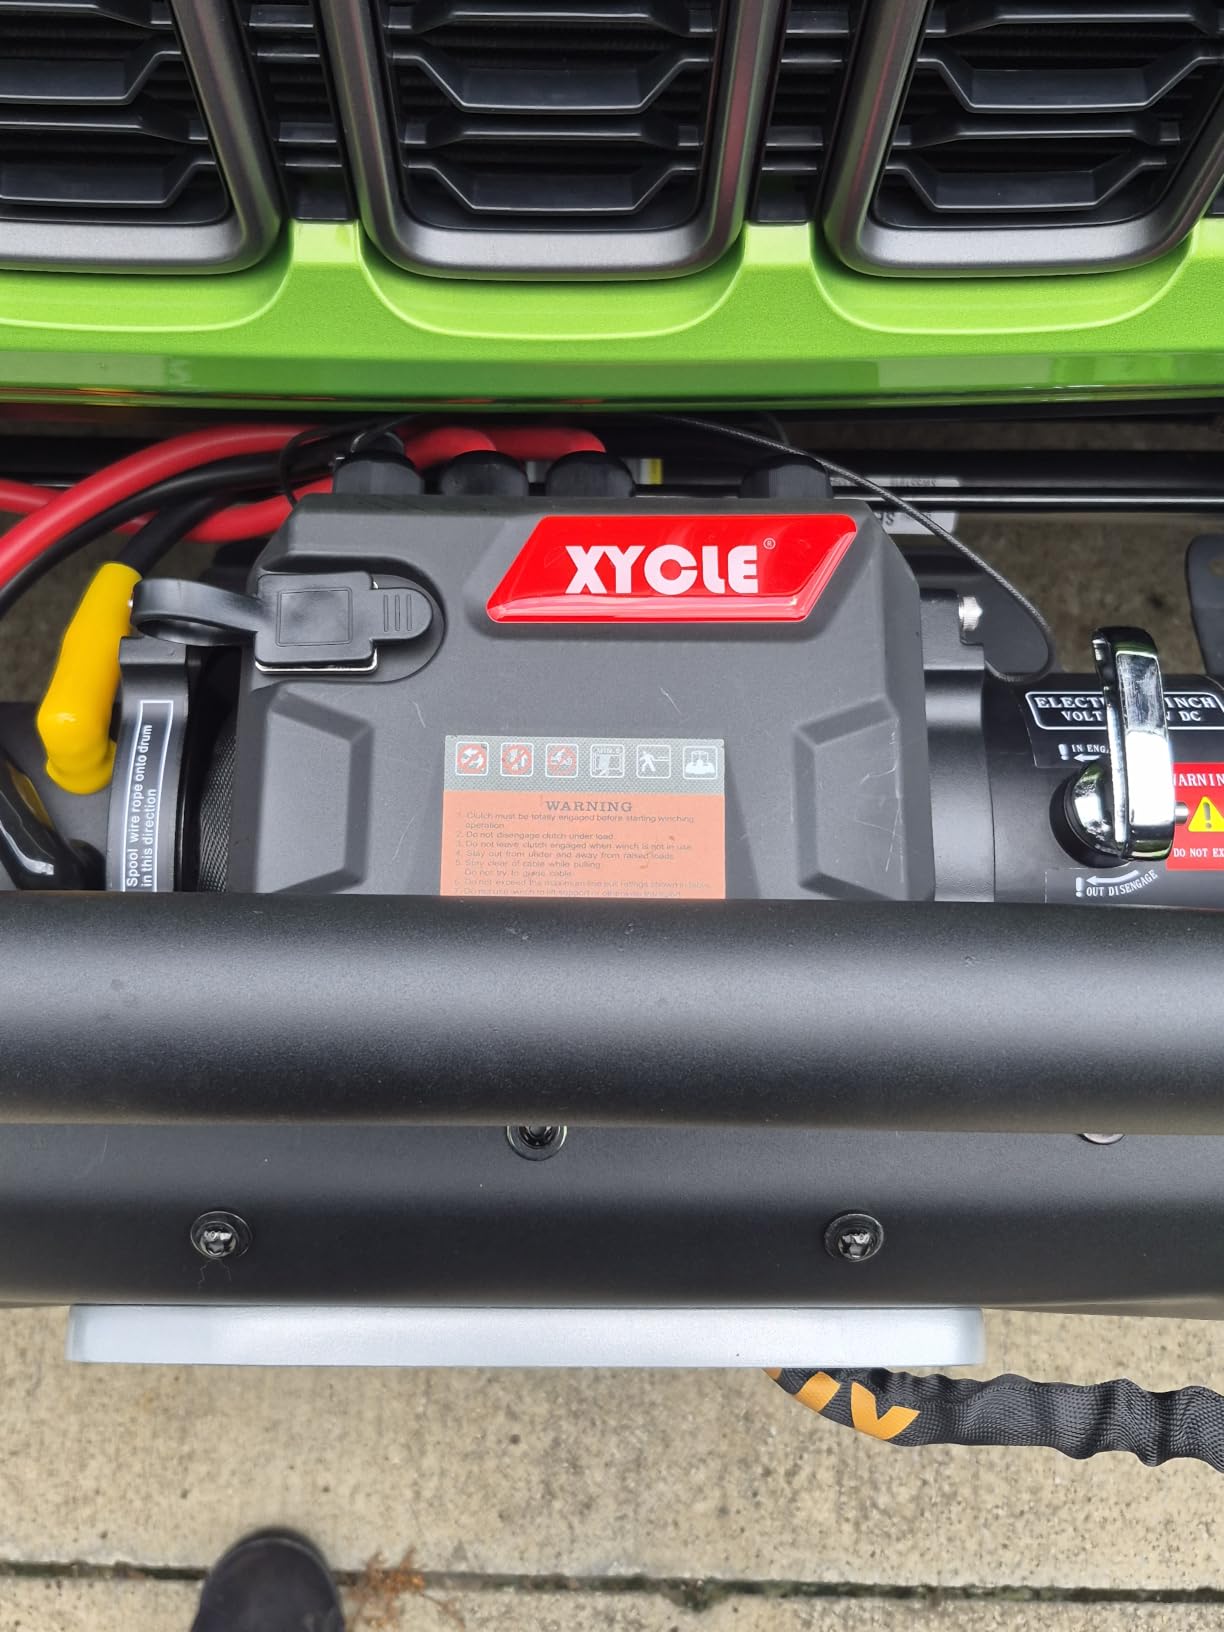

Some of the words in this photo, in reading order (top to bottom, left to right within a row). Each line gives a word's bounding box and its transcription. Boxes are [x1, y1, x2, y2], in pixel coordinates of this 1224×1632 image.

[565, 544, 759, 596] XYCLE
[1034, 696, 1105, 708] ELECT
[1163, 696, 1217, 708] INCH
[1178, 710, 1202, 722] DC
[137, 724, 153, 754] drum
[1071, 744, 1086, 752] IN
[1086, 744, 1110, 754] ENG
[134, 754, 148, 782] onto
[1173, 772, 1224, 787] ARNIN
[132, 783, 145, 812] rope
[546, 800, 632, 812] WARNING
[141, 788, 157, 845] direction
[531, 813, 556, 822] totally
[558, 814, 594, 823] engaged
[128, 814, 140, 844] wire
[496, 831, 540, 840] disengage
[550, 842, 587, 851] engaged
[1173, 847, 1186, 858] DO
[1190, 847, 1208, 858] NOT
[140, 848, 153, 872] this
[466, 850, 486, 858] Stay
[126, 848, 140, 888] Spool
[140, 874, 153, 888] in
[1086, 886, 1105, 897] OUT
[1108, 869, 1159, 897] DISENGAGE
